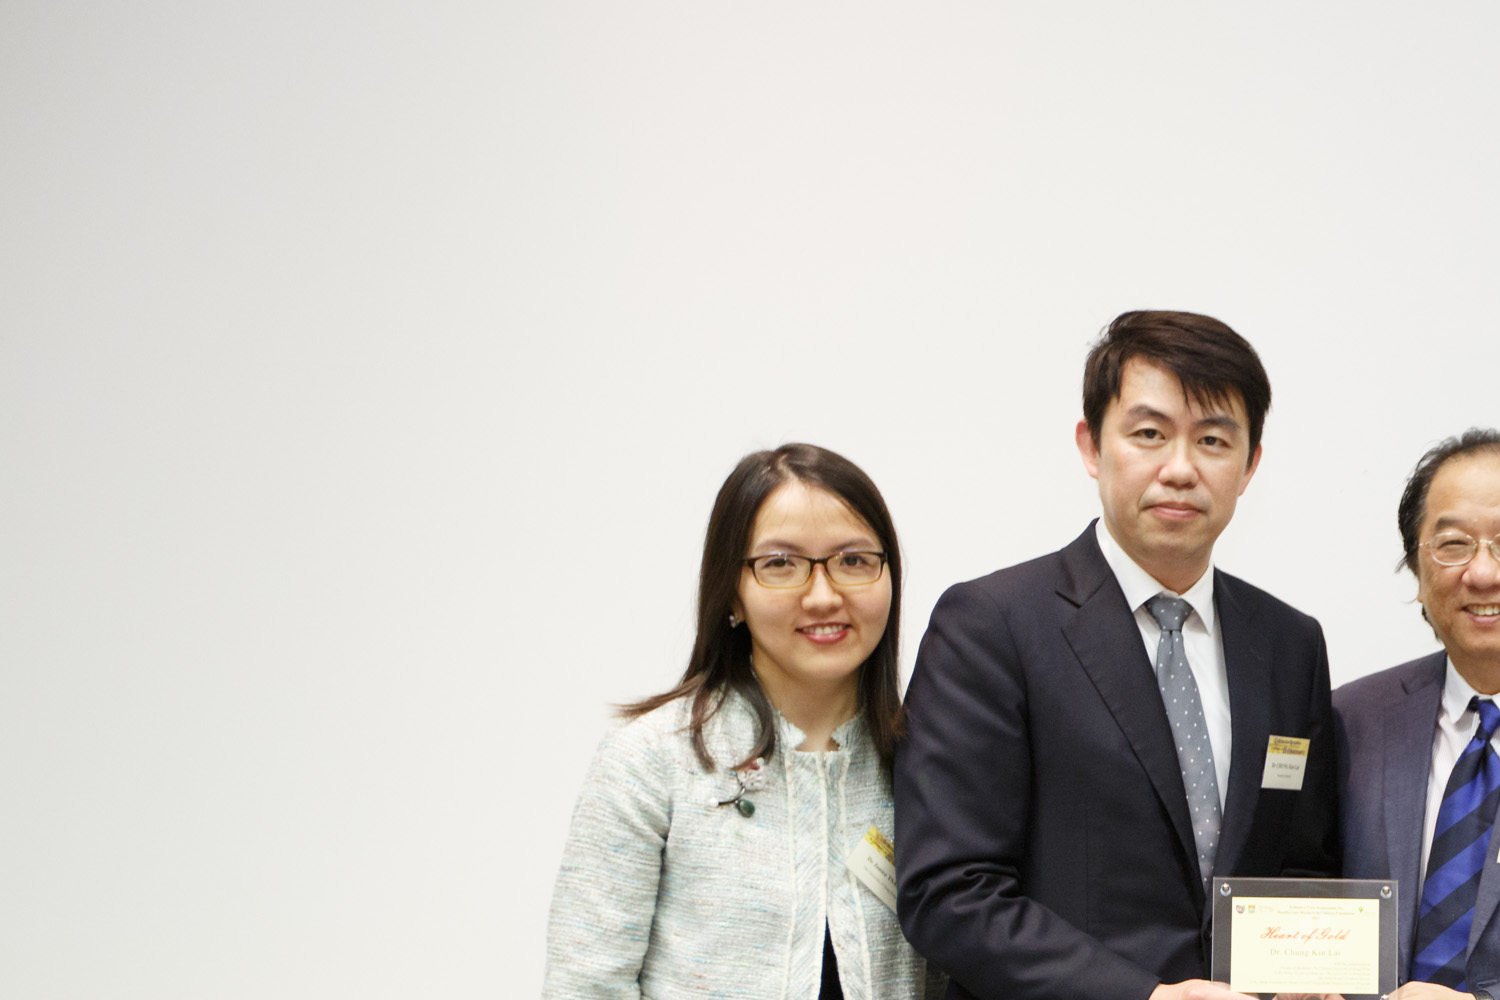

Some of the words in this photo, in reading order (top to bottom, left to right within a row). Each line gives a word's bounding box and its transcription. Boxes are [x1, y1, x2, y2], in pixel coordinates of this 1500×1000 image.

[1260, 926, 1300, 940] Heart
[1301, 928, 1319, 944] of
[1316, 926, 1351, 941] Gold
